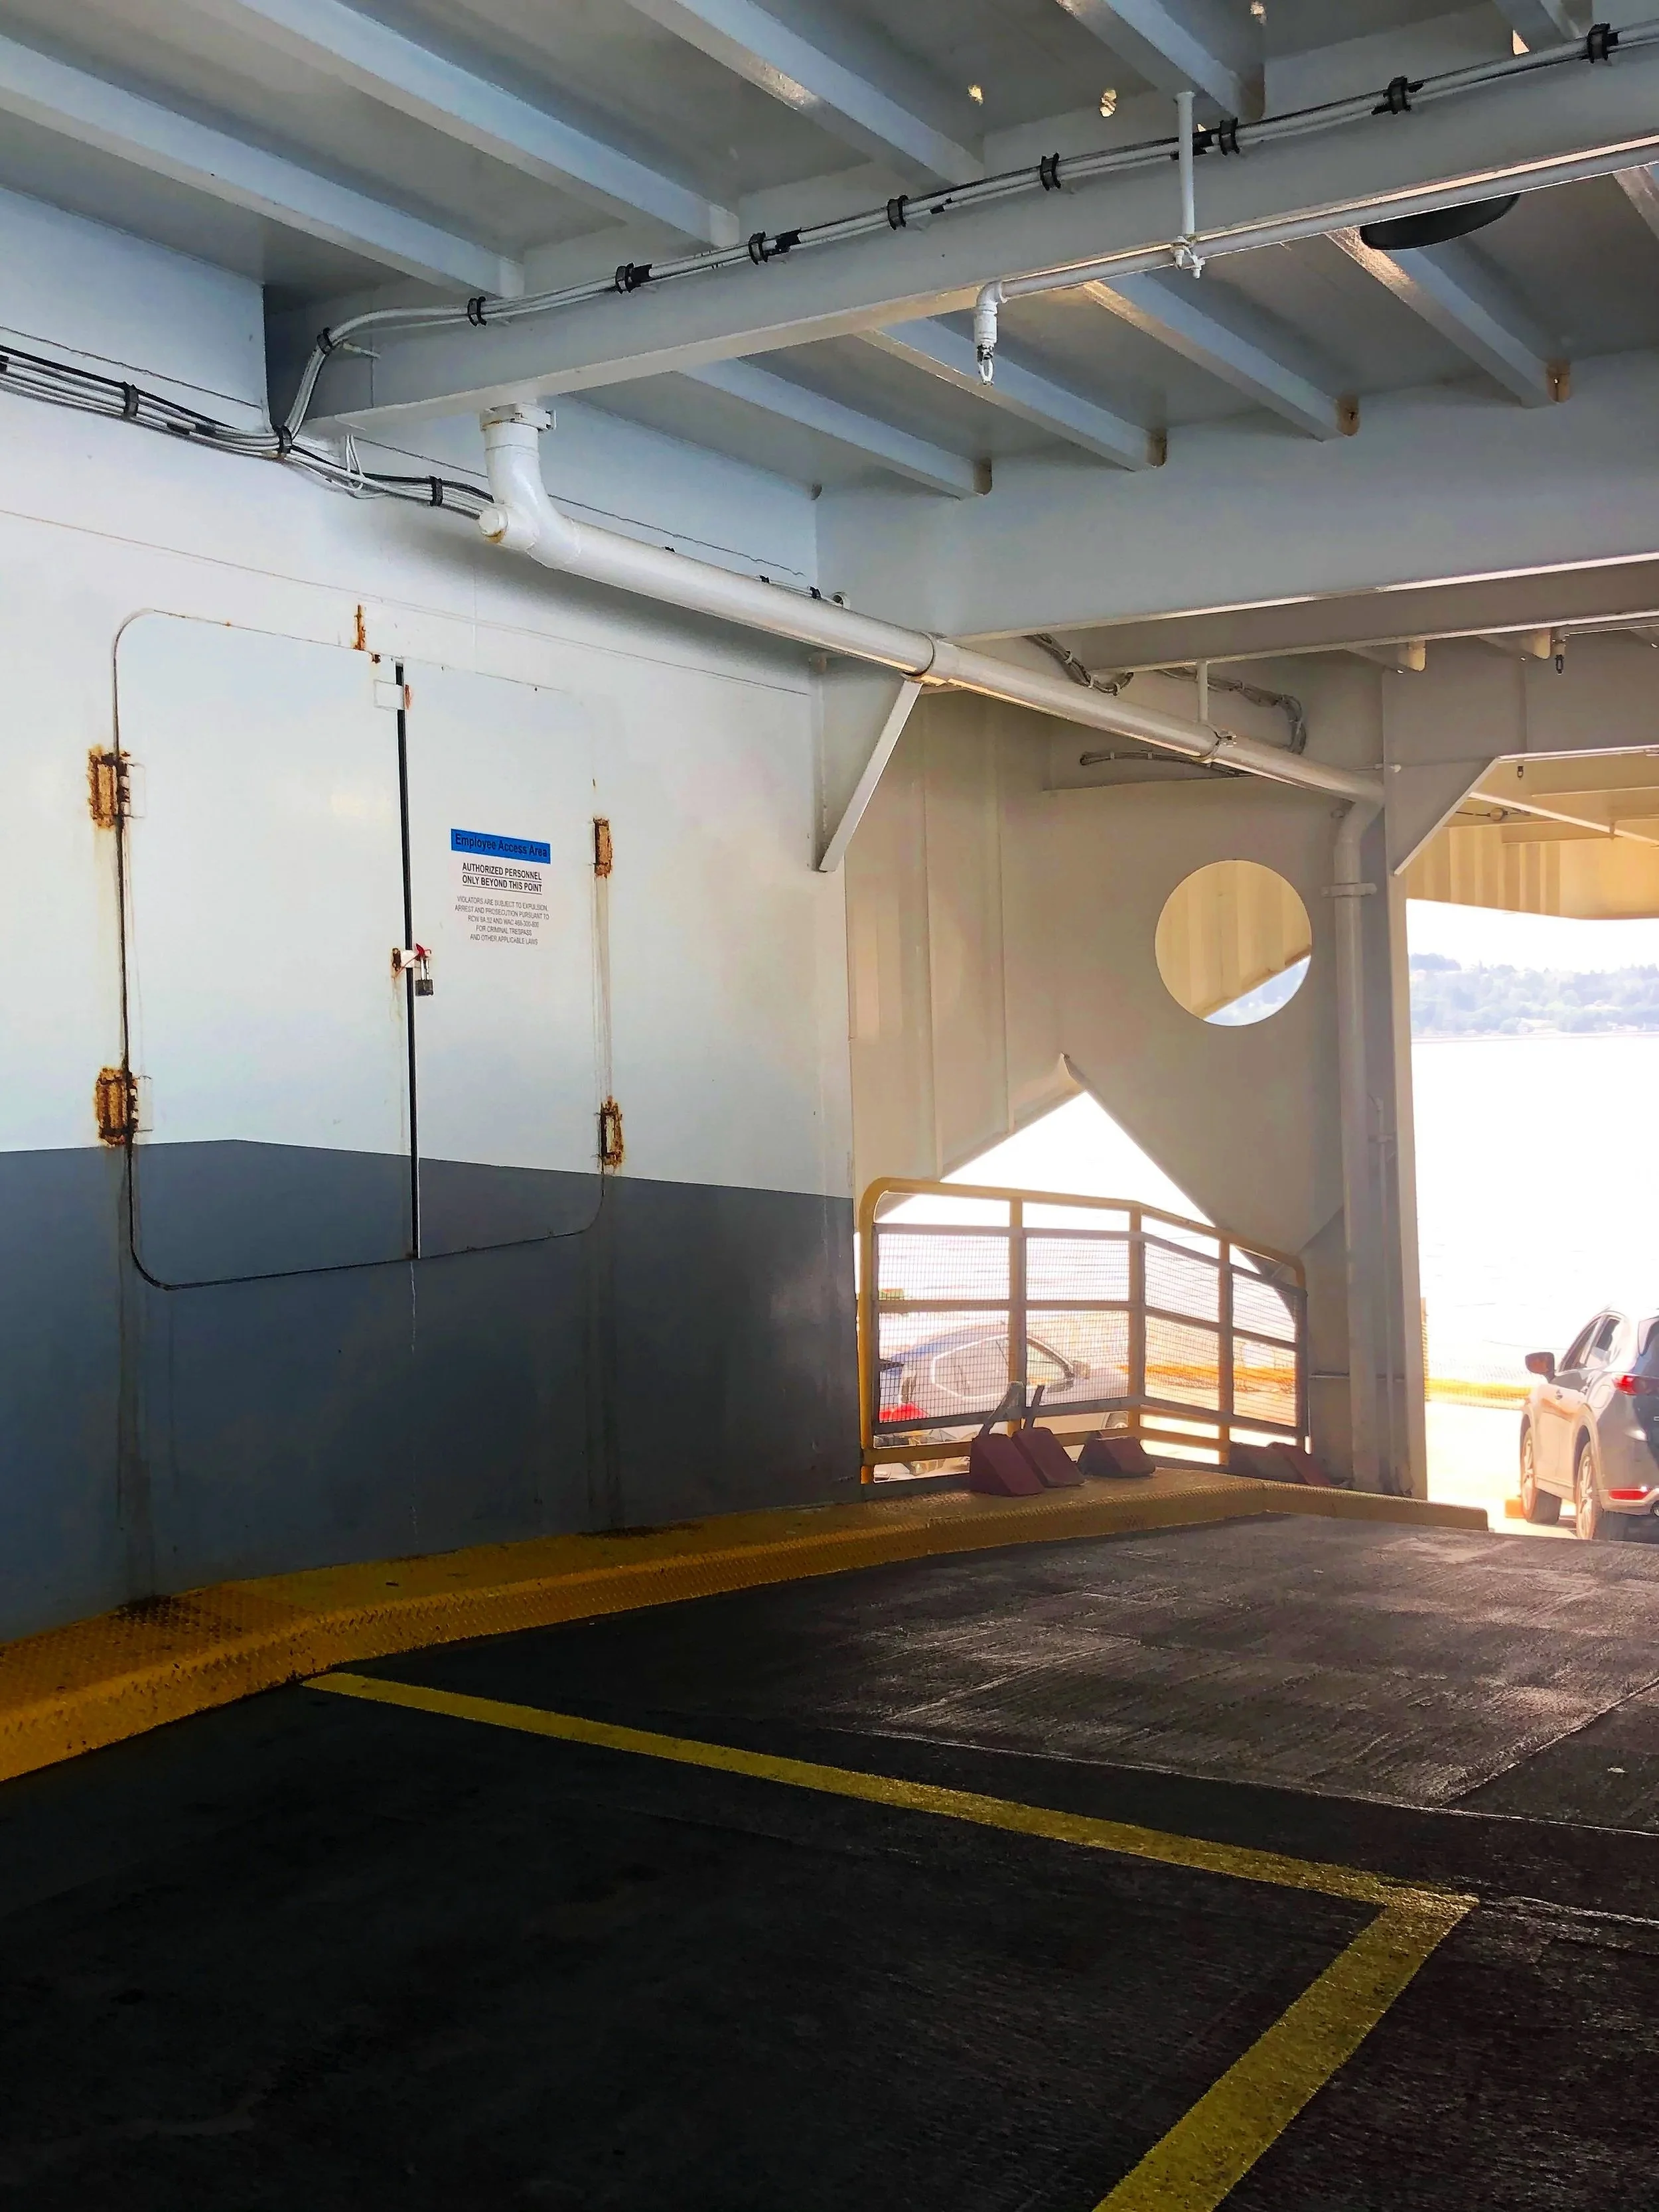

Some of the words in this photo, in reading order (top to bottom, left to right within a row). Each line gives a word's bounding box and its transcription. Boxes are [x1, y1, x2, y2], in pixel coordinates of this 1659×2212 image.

[455, 833, 496, 851] Employee
[498, 840, 528, 855] Access
[529, 845, 547, 857] Area
[463, 863, 503, 875] AUTHORIZED
[504, 868, 542, 880] PERSONNEL
[463, 875, 478, 885] ONLY
[481, 877, 507, 888] BEYOND
[509, 881, 523, 890] THIS
[524, 883, 542, 892] POINT
[457, 895, 483, 905] VIOLATORS
